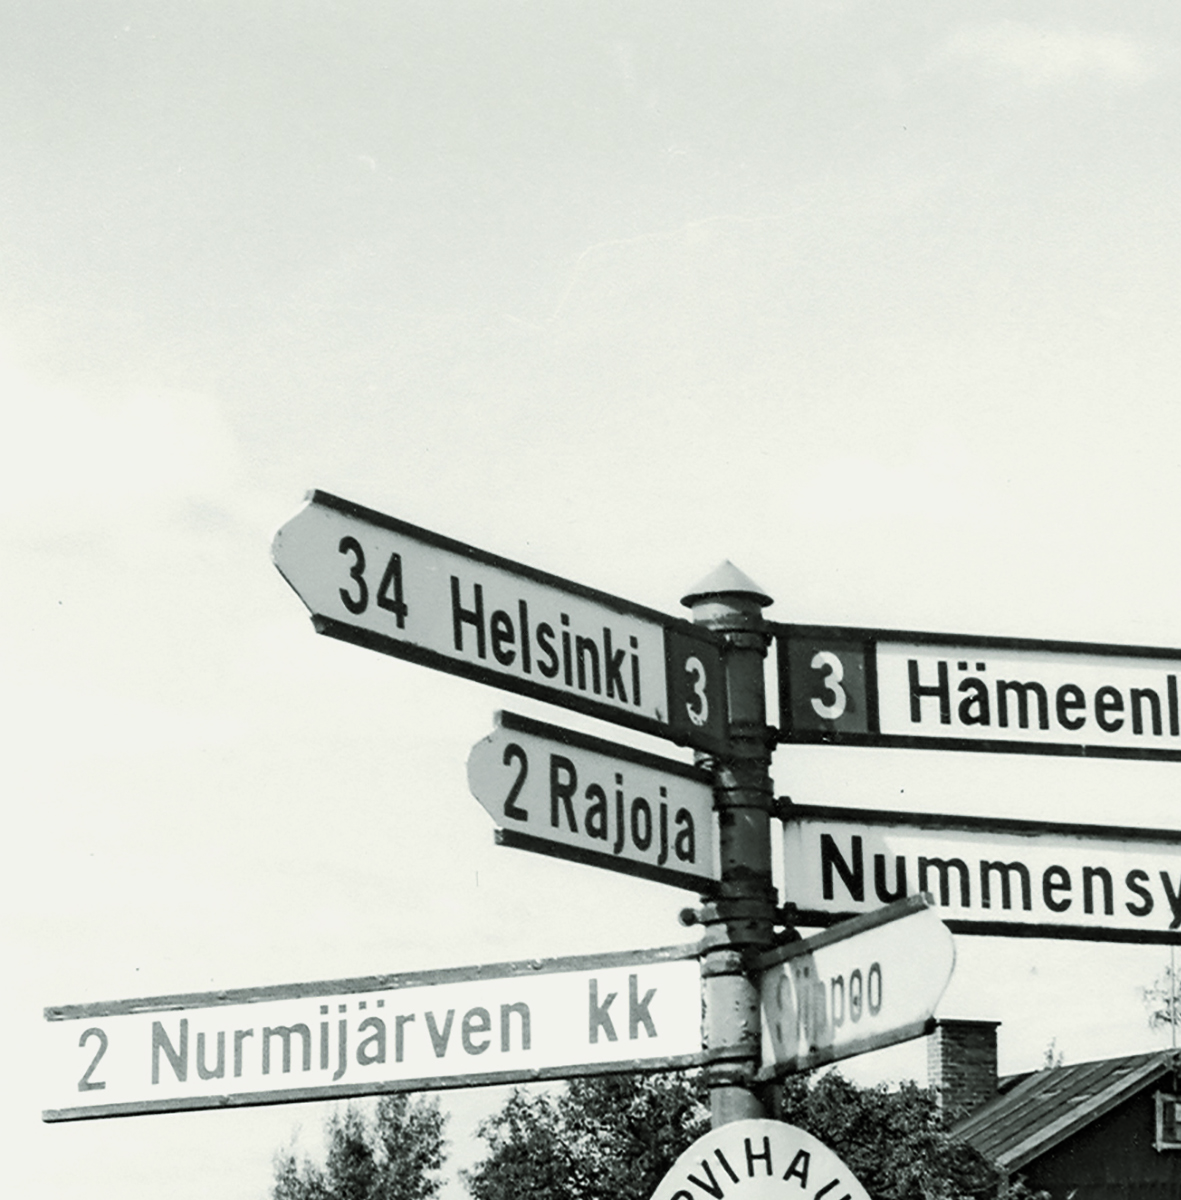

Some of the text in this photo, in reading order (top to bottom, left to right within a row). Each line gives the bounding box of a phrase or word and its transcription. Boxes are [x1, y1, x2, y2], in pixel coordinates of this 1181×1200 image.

[338, 535, 707, 726] 34 Helsinki 3
[810, 651, 847, 719] 3
[503, 743, 695, 867] 2 Rajoja
[77, 974, 658, 1092] 2 Nurmijärven kk
